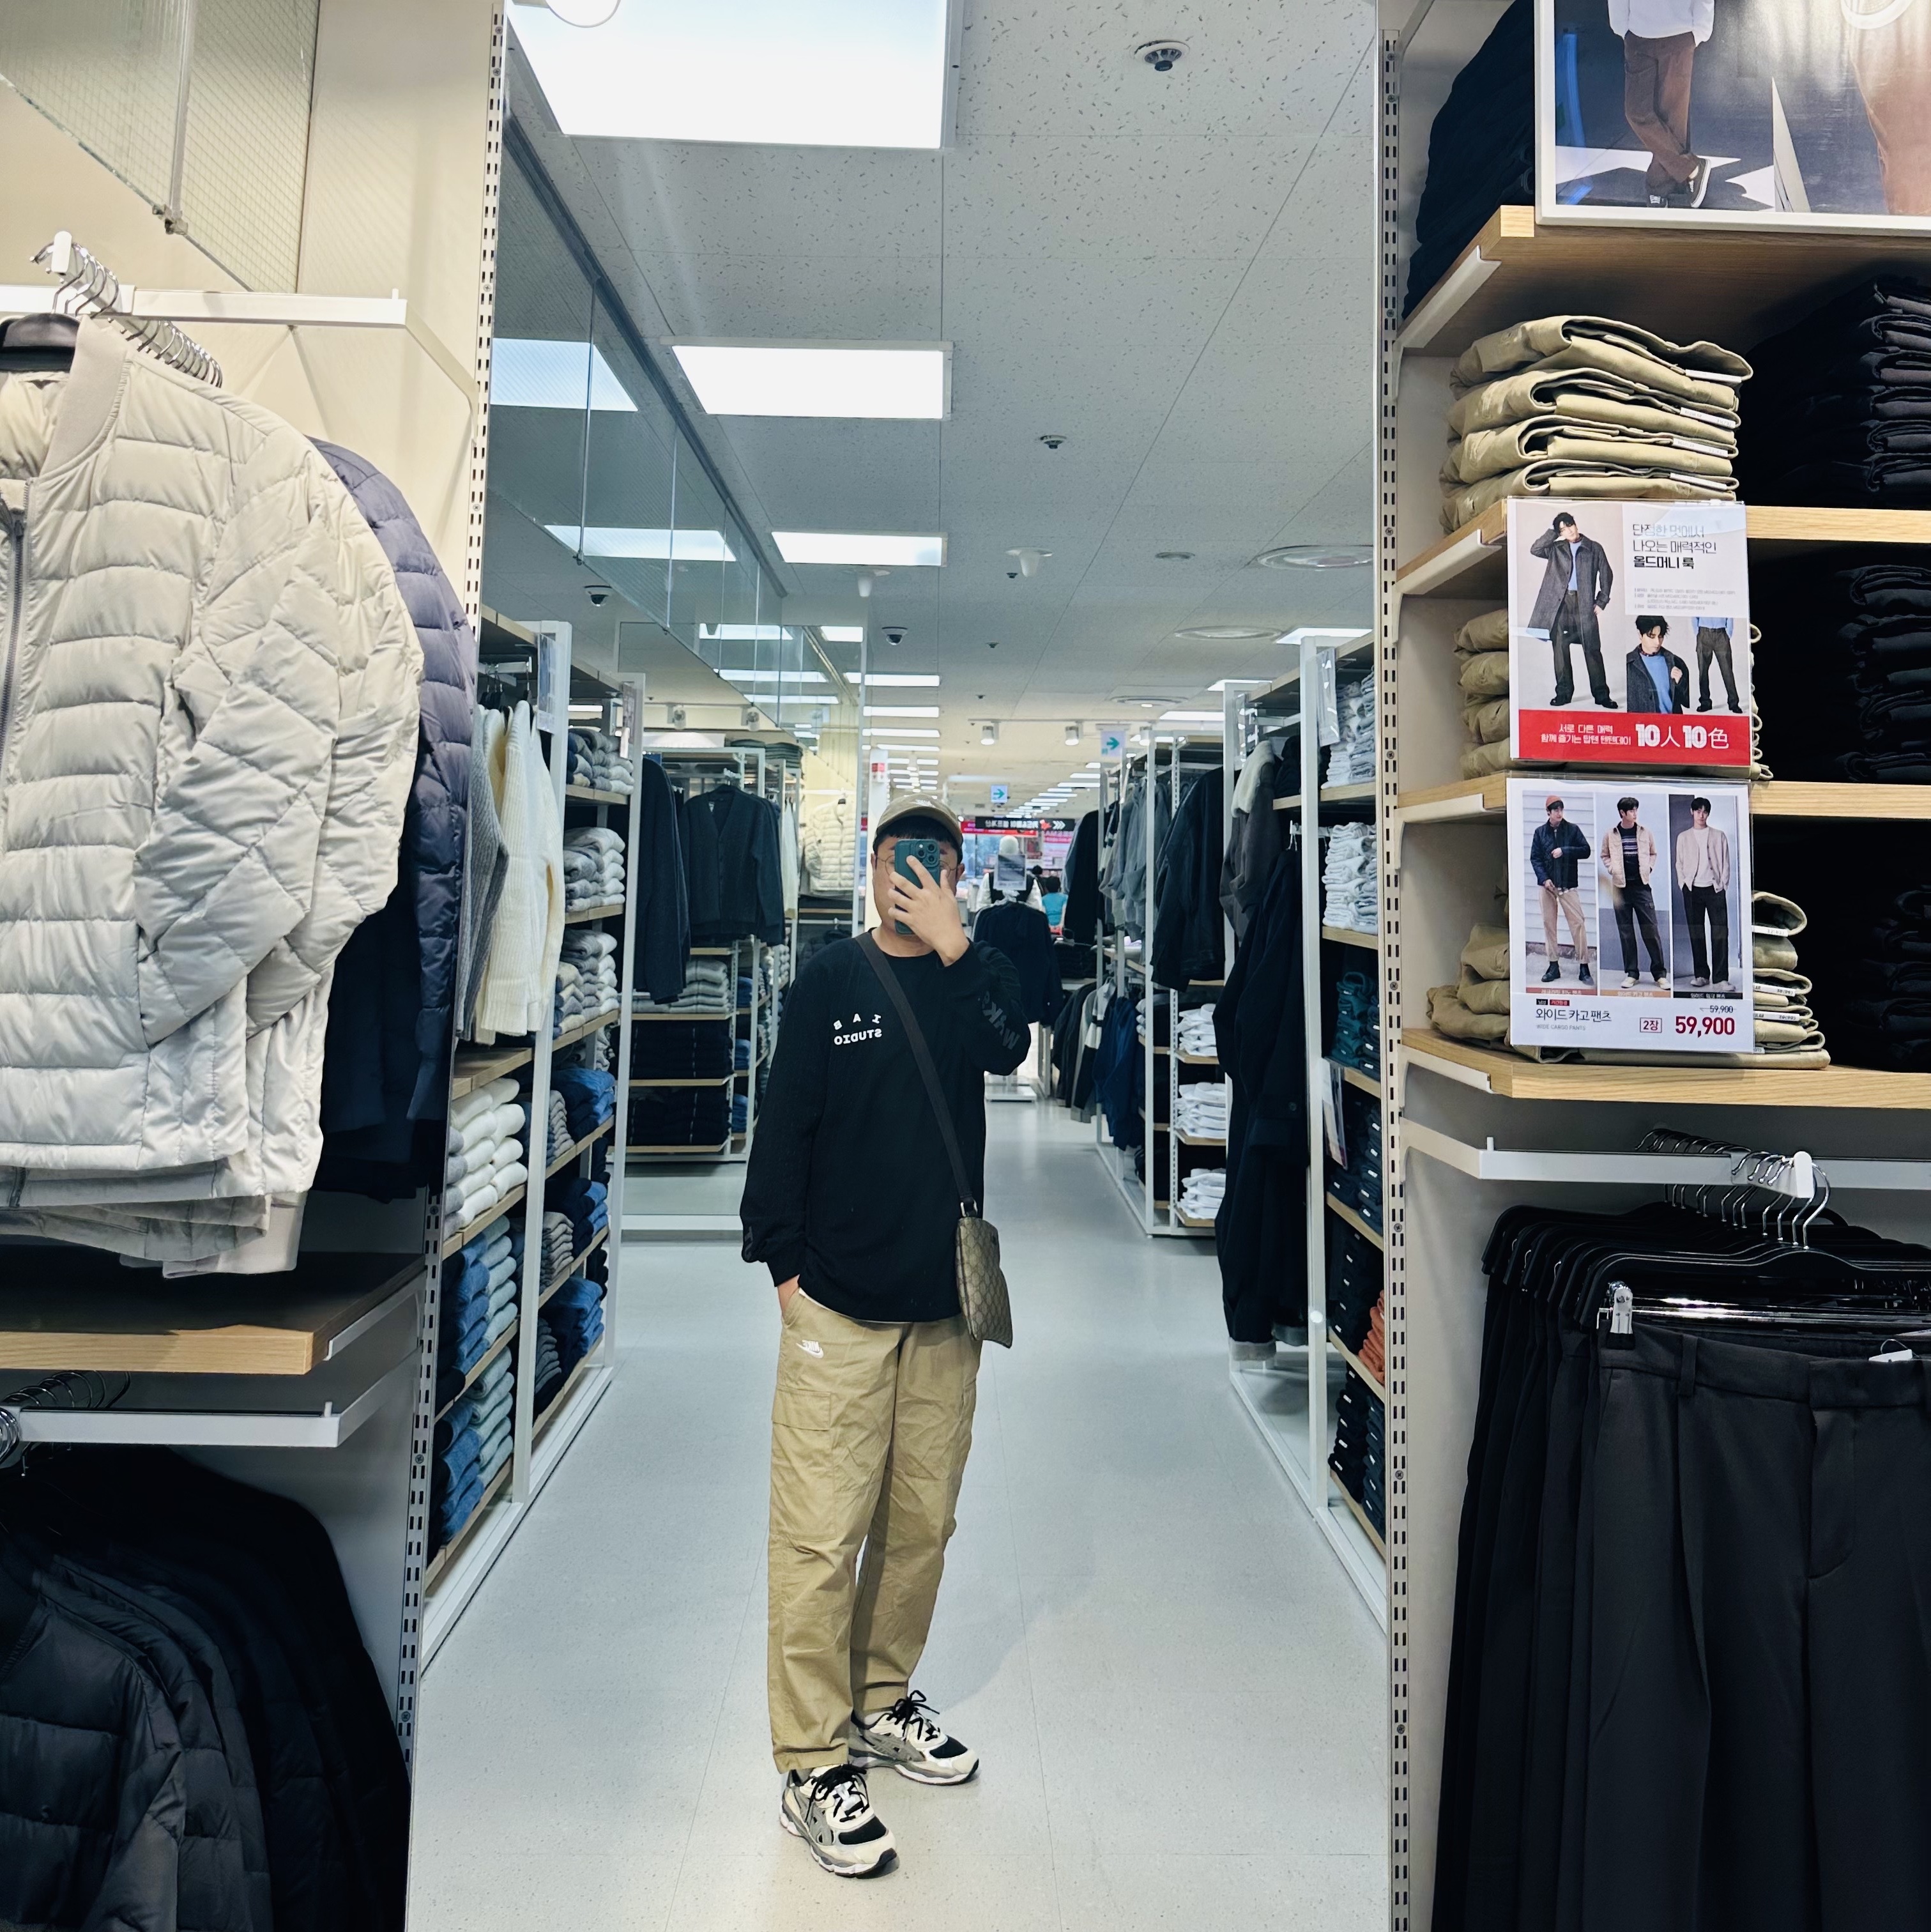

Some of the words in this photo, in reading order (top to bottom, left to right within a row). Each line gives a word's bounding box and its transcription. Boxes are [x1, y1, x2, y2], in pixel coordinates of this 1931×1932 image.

[1669, 525, 1704, 538] 멋에서
[1633, 540, 1668, 553] 나오는
[1670, 540, 1716, 554] 매력적인
[1633, 555, 1679, 569] 올드머니
[1682, 556, 1694, 569] 룩
[1559, 723, 1575, 733] 서로
[1578, 724, 1594, 733] 다른
[1597, 724, 1614, 734] 매력
[1540, 733, 1557, 743] 함께
[1558, 734, 1582, 744] 즐기는
[1709, 1005, 1734, 1015] 59,900
[1643, 1020, 1659, 1031] 2장
[1675, 1016, 1735, 1038] 59,900
